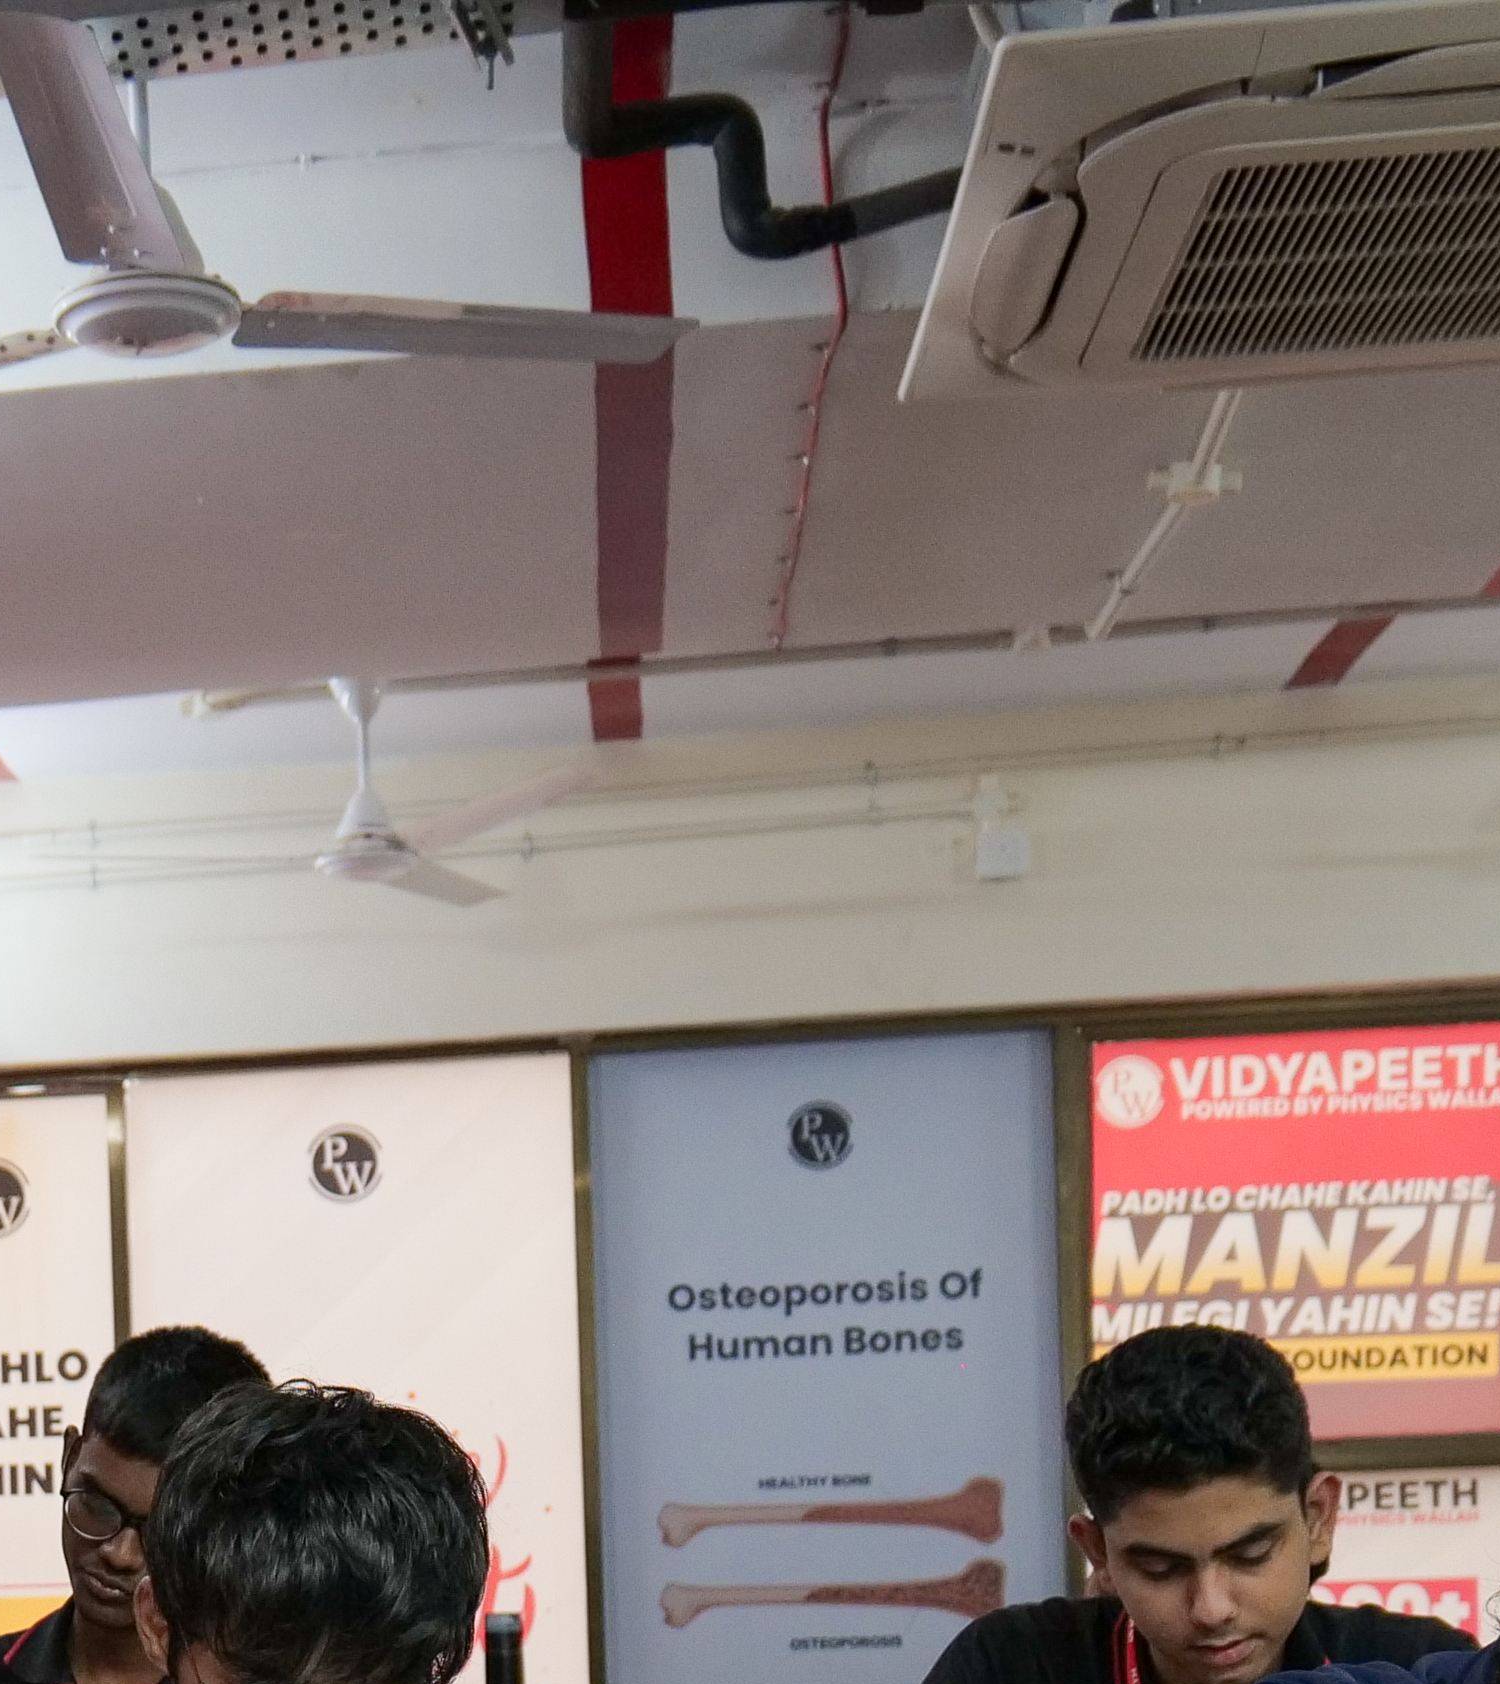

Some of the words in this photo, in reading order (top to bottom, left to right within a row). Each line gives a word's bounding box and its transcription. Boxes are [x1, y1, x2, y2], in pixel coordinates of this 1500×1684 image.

[1109, 1066, 1158, 1120] PW
[1182, 1095, 1289, 1121] POWERED
[1294, 1094, 1324, 1115] BY
[1327, 1090, 1426, 1114] PHYSICS
[800, 1109, 846, 1164] PW
[321, 1134, 374, 1196] PW
[1102, 1187, 1188, 1217] PADH
[1191, 1185, 1230, 1213] LO
[1235, 1181, 1344, 1210] CHAHE
[1346, 1177, 1448, 1207] KAHIN
[667, 1271, 929, 1317] Osteoporosis
[939, 1267, 983, 1300] Of
[1260, 1293, 1417, 1336] YAHIN
[687, 1331, 834, 1361] Human
[843, 1326, 964, 1355] Bones
[1345, 1479, 1479, 1511] PEETH
